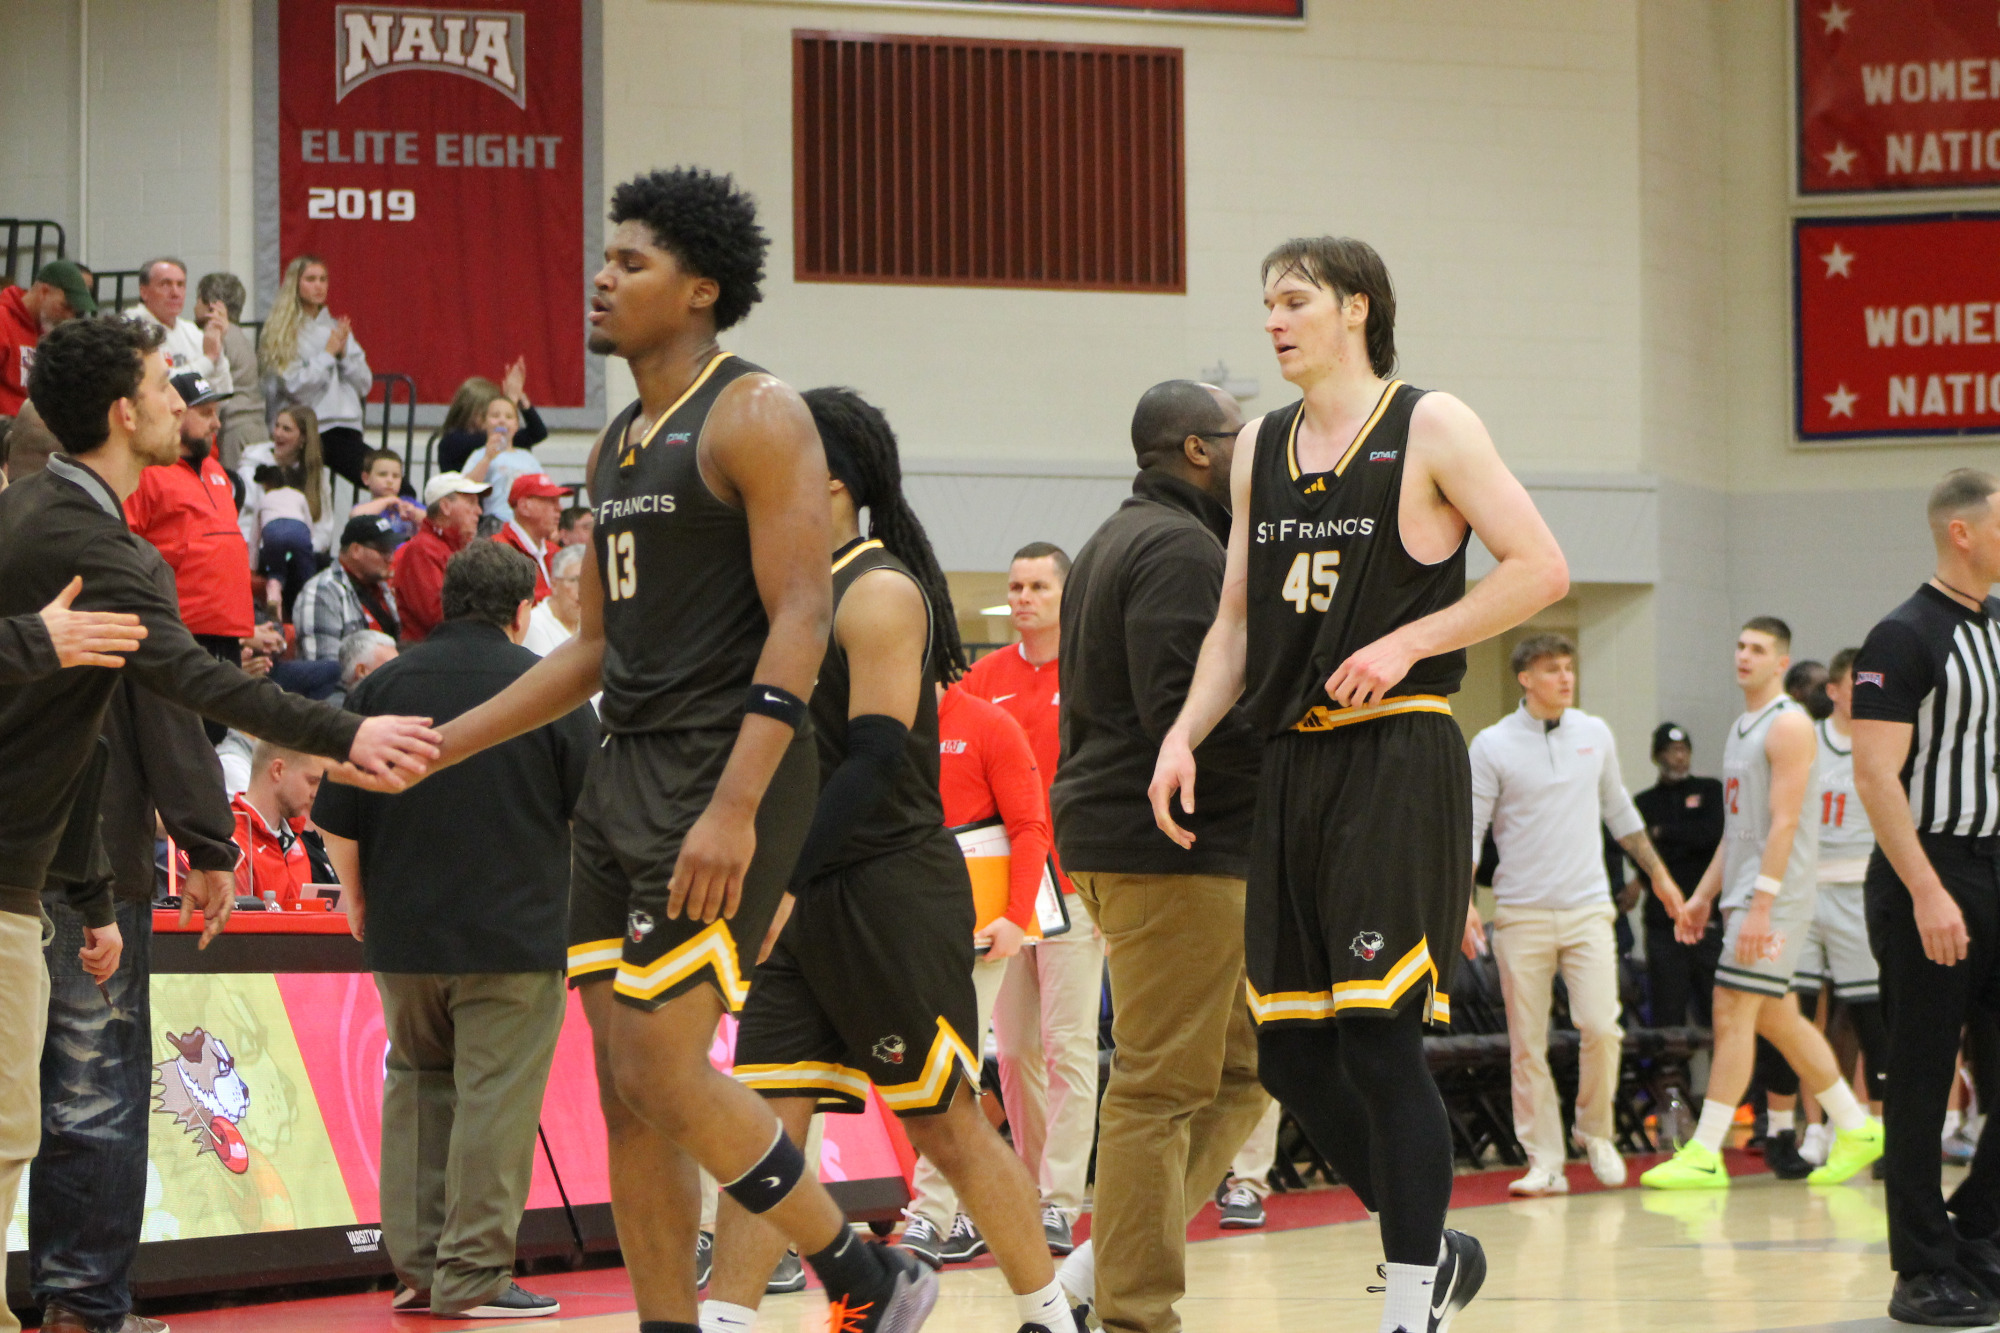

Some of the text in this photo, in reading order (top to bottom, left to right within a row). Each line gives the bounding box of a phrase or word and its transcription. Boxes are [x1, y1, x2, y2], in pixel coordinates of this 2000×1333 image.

[344, 14, 516, 90] NAIA
[301, 129, 563, 169] ELITE EIGHT
[307, 186, 416, 222] 2019
[600, 494, 676, 525] FRANCIS
[607, 531, 637, 601] 13
[1281, 550, 1341, 613] 45
[1821, 791, 1846, 827] 11
[346, 1229, 375, 1245] VARSITY
